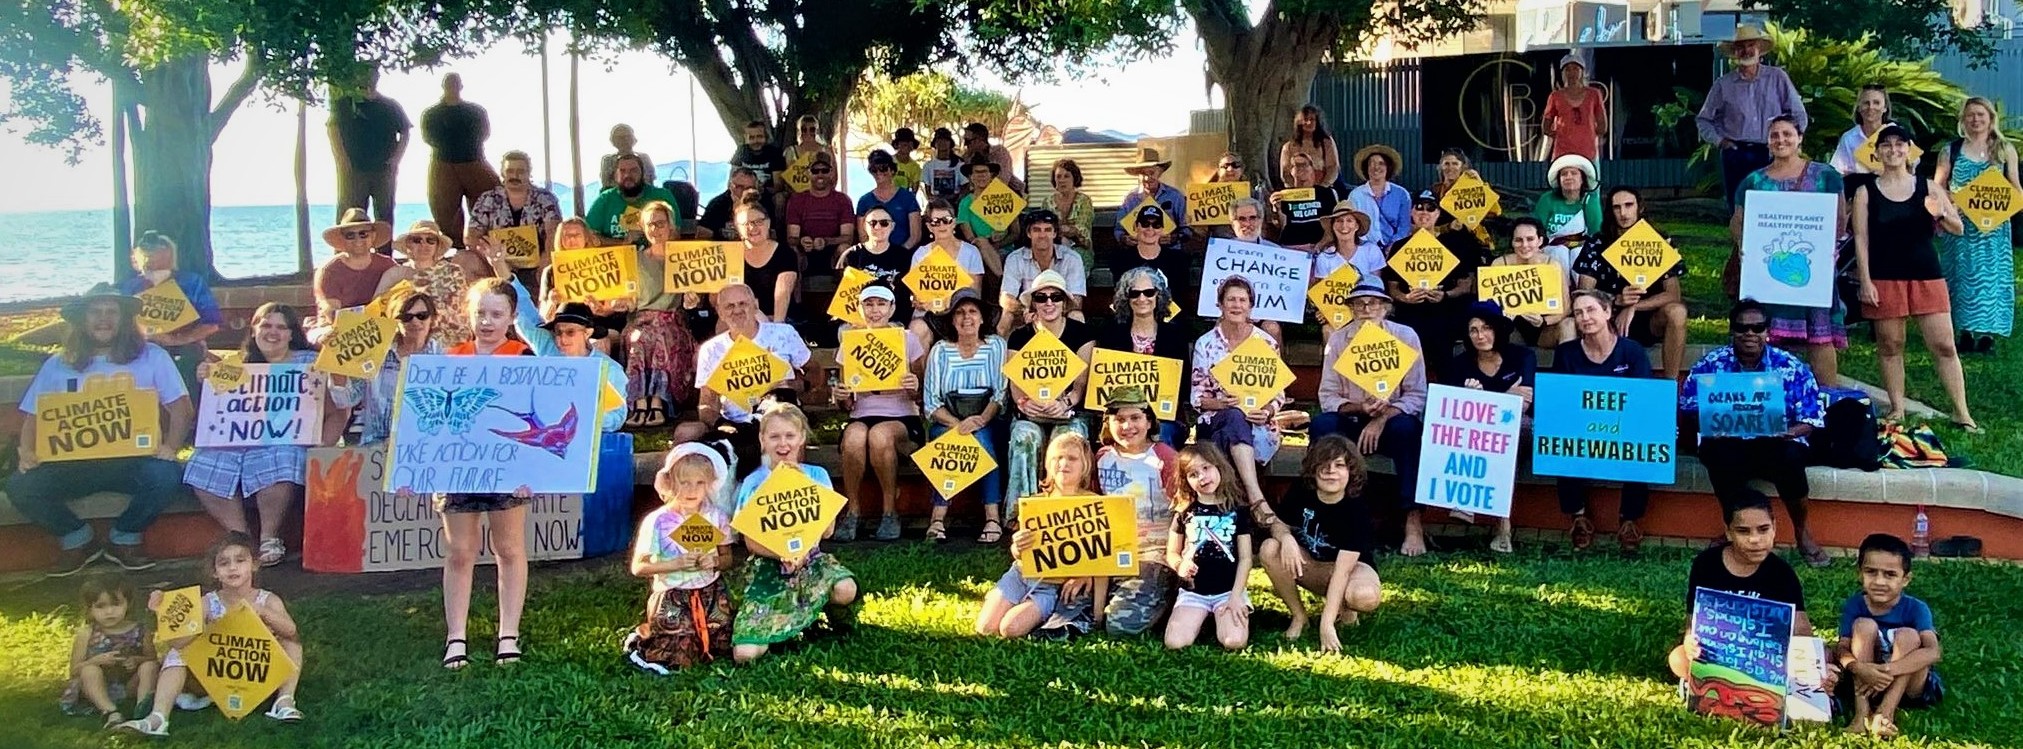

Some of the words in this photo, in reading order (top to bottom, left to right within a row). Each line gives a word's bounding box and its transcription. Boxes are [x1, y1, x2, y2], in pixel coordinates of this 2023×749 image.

[1190, 184, 1232, 201] CLIMATE
[1970, 185, 2011, 193] CLIMATE
[1974, 192, 2011, 200] ACTION
[984, 204, 1014, 215] NOW
[1198, 192, 1236, 208] ACTION
[1454, 198, 1486, 211] NOW
[1969, 198, 2010, 211] NOW
[1228, 245, 1263, 258] Learn
[1274, 253, 1286, 261] to
[1620, 240, 1663, 248] CLIMATE
[557, 250, 616, 273] CLIMATE
[669, 244, 724, 264] CLIMATE
[678, 254, 726, 271] ACTION
[1621, 255, 1662, 267] NOW
[570, 260, 618, 282] ACTION
[919, 265, 957, 273] CLIMATE
[924, 271, 957, 280] ACTION
[1216, 257, 1300, 280] CHANGE
[1405, 261, 1442, 272] NOW
[564, 270, 620, 298] NOW
[672, 264, 726, 289] NOW
[919, 279, 957, 291] NOW
[1481, 268, 1538, 288] CLIMATE
[1492, 277, 1542, 296] ACTION
[1323, 294, 1345, 305] NO
[329, 318, 377, 348] CLIMATE
[340, 325, 379, 351] ACTION
[336, 332, 382, 366] NOW
[866, 332, 902, 364] CLIMATE
[1022, 349, 1067, 359] CLIMATE
[1350, 340, 1397, 354] CLIMATE
[1359, 348, 1399, 361] ACTION
[722, 354, 768, 370] CLIMATE
[851, 345, 892, 381] NOW
[864, 344, 898, 372] ACTION
[1028, 357, 1067, 366] ACTION
[1094, 360, 1159, 374] CLIMATE
[1232, 355, 1277, 366] CLIMATE
[1354, 356, 1400, 375] NOW
[452, 366, 468, 385] BE
[476, 366, 487, 385] A
[731, 362, 771, 377] ACTION
[1022, 366, 1067, 380] NOW
[1104, 372, 1160, 384] ACTION
[1237, 364, 1277, 374] ACTION
[726, 371, 771, 391] NOW
[1230, 372, 1276, 388] NOW
[42, 394, 127, 421] CLIMATE
[227, 395, 300, 412] action
[1582, 390, 1628, 411] REEF
[58, 406, 130, 432] ACTION
[1441, 397, 1447, 418] I
[1452, 399, 1498, 425] LOVE
[230, 418, 302, 442] NOW!
[1587, 417, 1620, 434] and
[1711, 412, 1733, 432] SO
[1734, 413, 1765, 433] ARE
[48, 419, 132, 455] NOW
[1431, 423, 1464, 448] THE
[1468, 429, 1512, 454] REEF
[432, 442, 485, 462] ACTION
[490, 444, 519, 462] FOR
[934, 442, 980, 454] CLIMATE
[938, 451, 979, 461] ACTION
[1538, 436, 1670, 463] RENEWABLES
[930, 457, 978, 473] NOW
[1444, 452, 1487, 479] AND
[756, 485, 817, 506] CLIMATE
[1429, 478, 1437, 500] I
[1445, 480, 1495, 510] VOTE
[767, 495, 820, 514] ACTION
[760, 505, 820, 532] NOW
[1025, 501, 1106, 532] CLIMATE
[534, 518, 580, 552] NOW
[1040, 516, 1110, 545] ACTION
[1032, 532, 1112, 573] NOW
[169, 600, 194, 632] NOW
[208, 633, 270, 650] CLIMATE
[216, 646, 270, 664] ACTION
[1748, 648, 1783, 667] Strait
[206, 658, 269, 683] NOW
[1745, 661, 1764, 675] as
